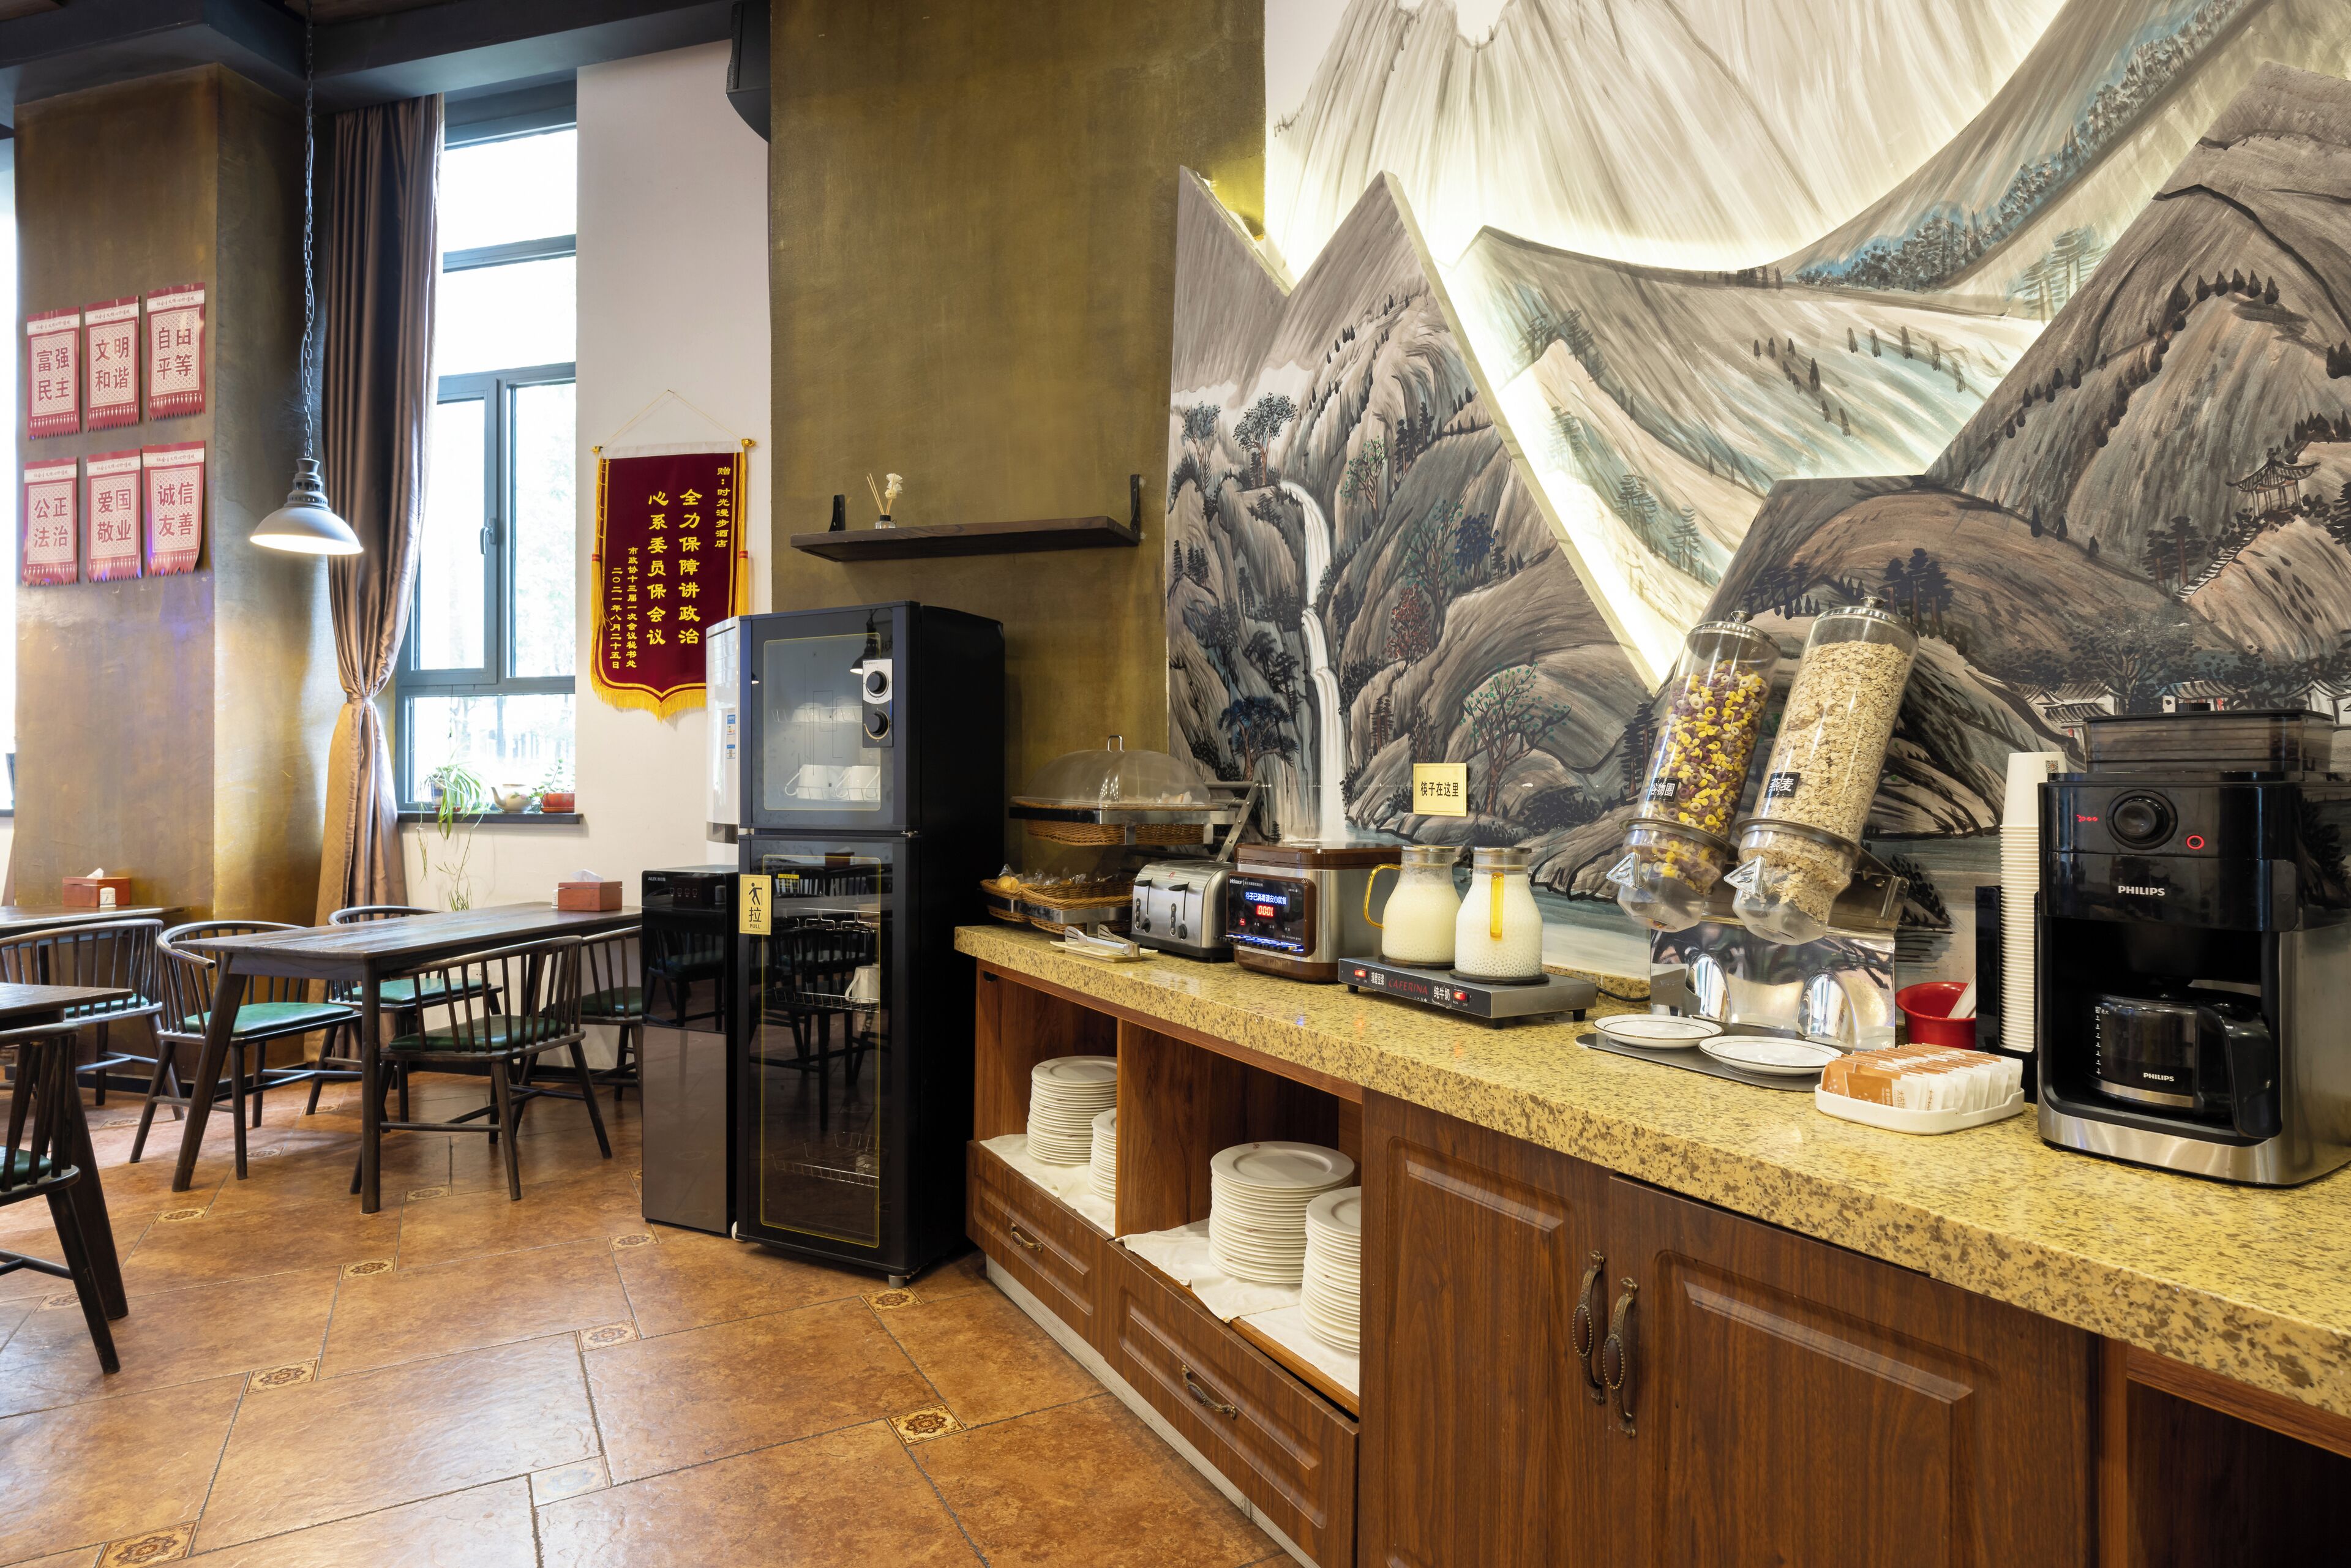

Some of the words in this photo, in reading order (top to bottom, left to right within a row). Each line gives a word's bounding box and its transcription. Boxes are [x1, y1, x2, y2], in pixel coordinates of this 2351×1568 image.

[95, 336, 130, 362] 文明
[158, 326, 191, 350] 自由
[36, 347, 69, 373] 富强
[156, 354, 193, 380] 平等
[37, 377, 69, 402] 民主
[95, 367, 130, 392] 和谐
[97, 489, 131, 513] 爱国
[158, 482, 194, 506] 诚信
[34, 496, 67, 519] 公正
[97, 519, 132, 543] 敬业
[158, 512, 194, 537] 友善
[34, 526, 69, 548] 法治
[647, 490, 669, 645] 心系委员保会议
[679, 489, 702, 644] 全力保障讲政治
[626, 547, 638, 668] 市政协十三届一次会议秘书处
[1420, 781, 1459, 797] 筷子在这里
[1650, 781, 1675, 797] 谷物圈
[1769, 778, 1794, 792] 燕麦
[1245, 891, 1287, 905] 筷子已消毒请安心就餐
[2118, 885, 2165, 896] PHILIPS
[749, 907, 762, 922] 拉
[1389, 979, 1428, 996] CAFERINA
[1433, 986, 1451, 1001] 纯牛奶
[2143, 1072, 2174, 1081] PHILIPS
